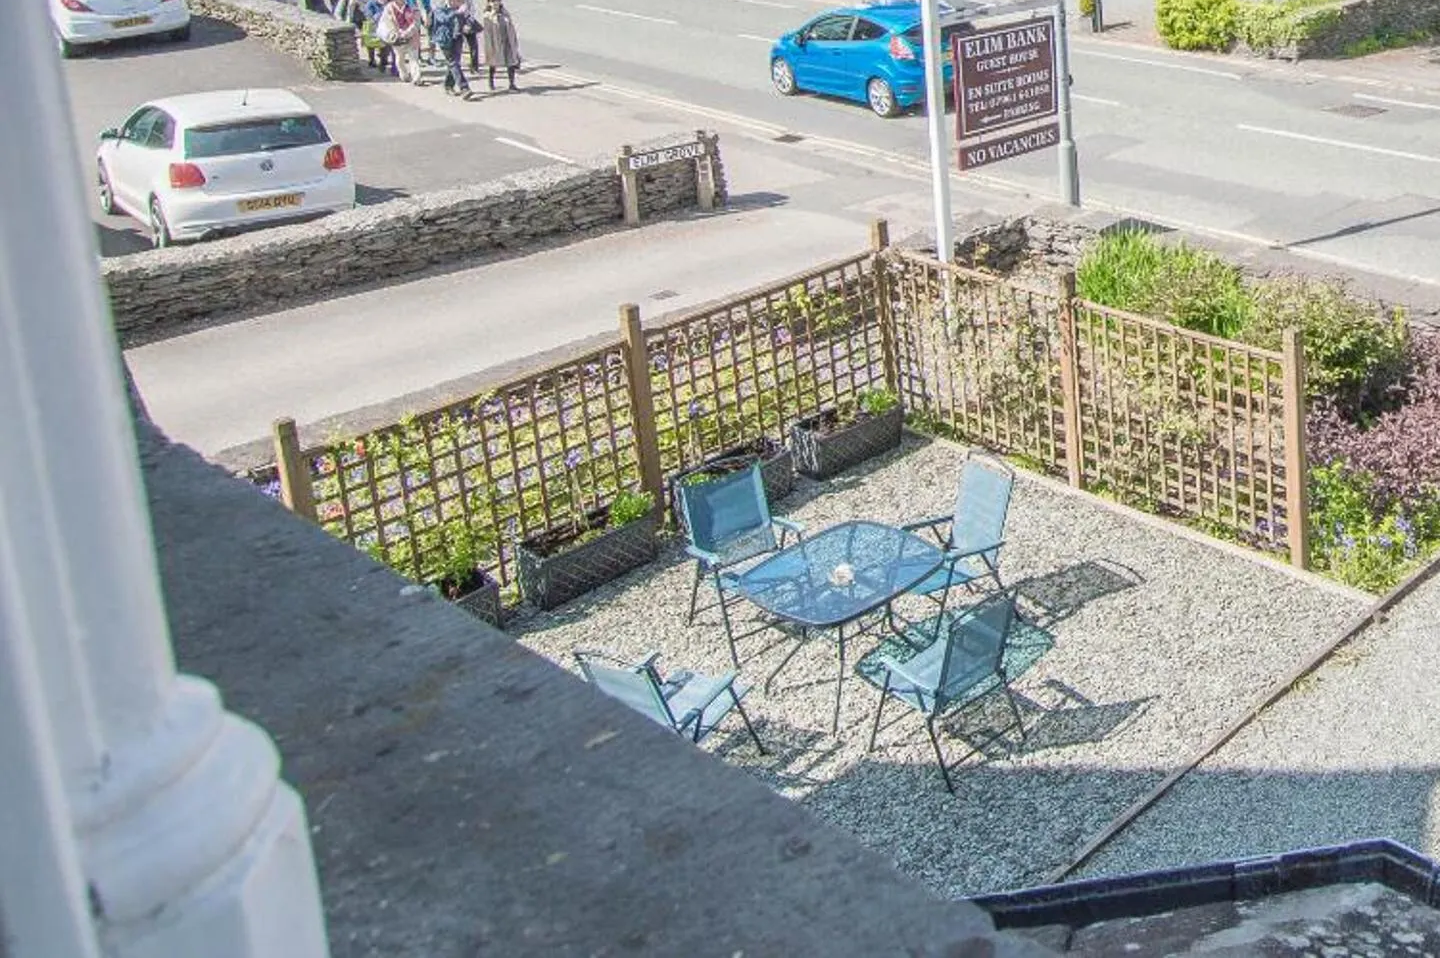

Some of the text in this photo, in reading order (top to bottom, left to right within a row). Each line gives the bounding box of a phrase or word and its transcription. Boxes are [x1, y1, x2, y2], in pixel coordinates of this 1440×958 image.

[965, 26, 1048, 58] ELIM BANK
[976, 49, 1040, 72] GUEST HOUSE
[967, 70, 1050, 101] EN SUITE ROOMS
[967, 129, 1056, 166] NO VACANCIES
